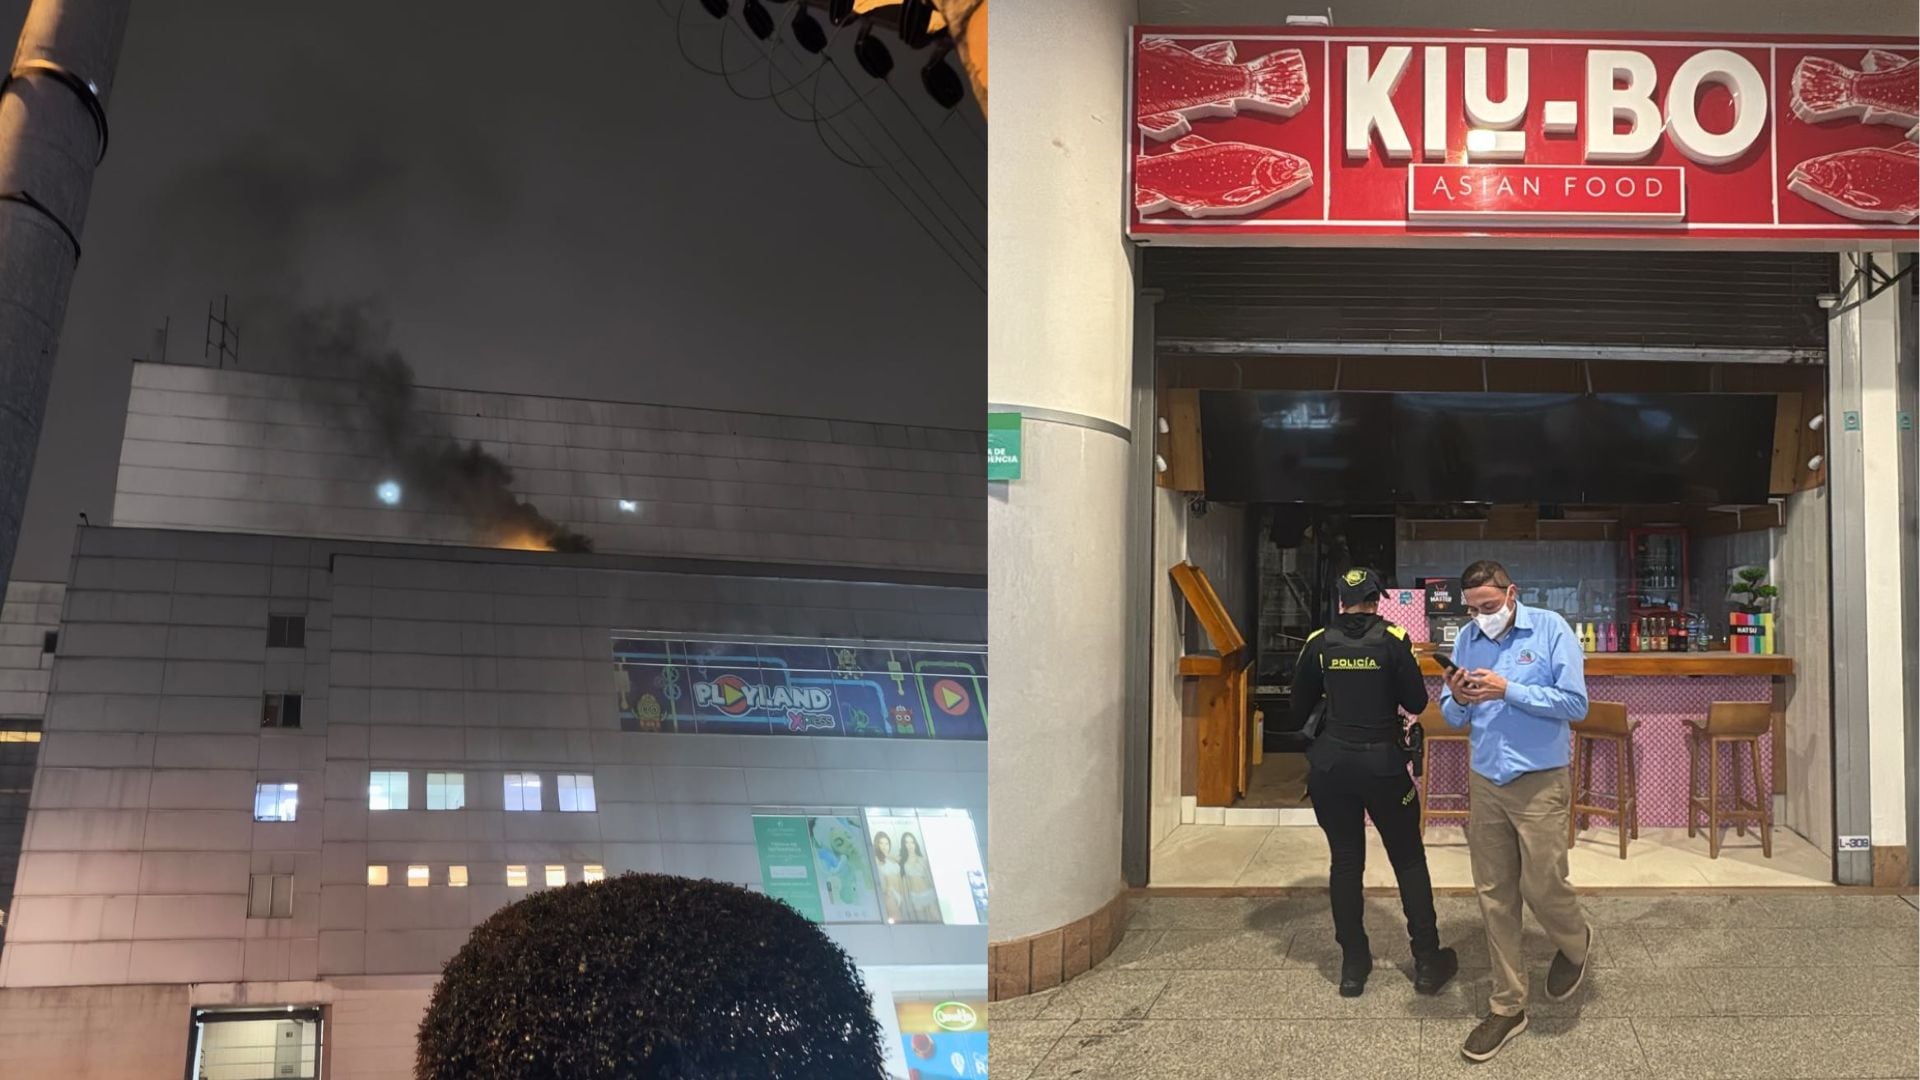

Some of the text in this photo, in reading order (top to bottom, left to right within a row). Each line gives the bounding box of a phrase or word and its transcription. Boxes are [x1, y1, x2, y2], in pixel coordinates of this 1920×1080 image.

[1346, 45, 1768, 166] KIU-BO
[1431, 175, 1663, 200] ASIAN FOOD
[1331, 656, 1377, 667] POLICÍA
